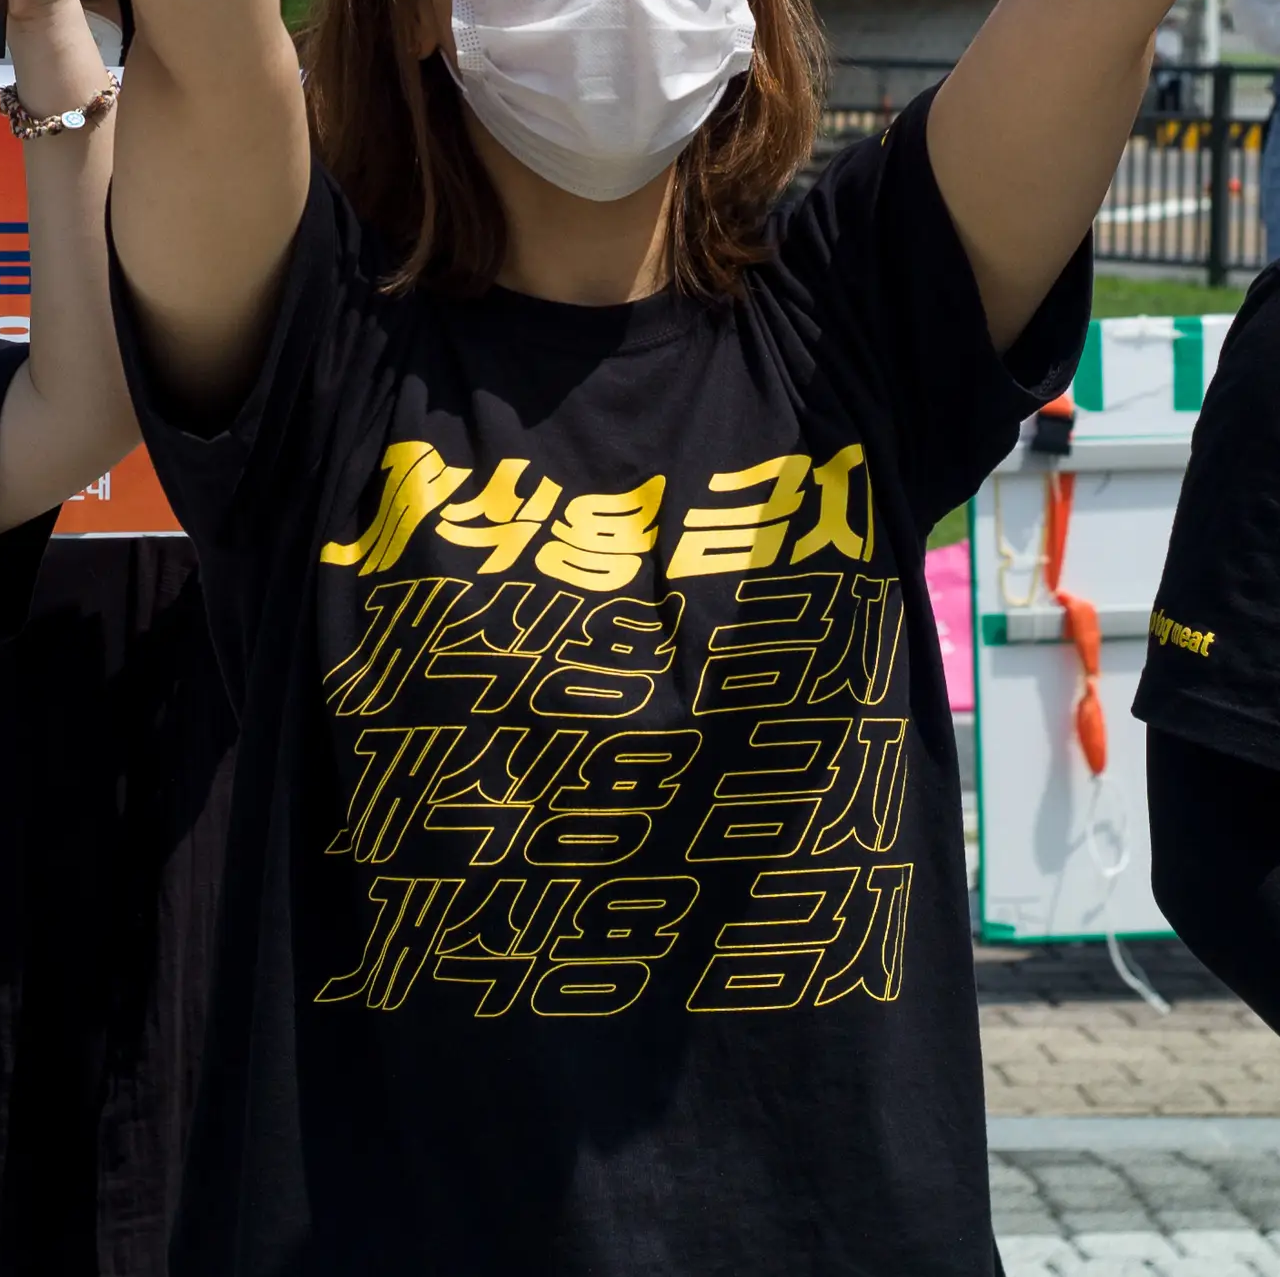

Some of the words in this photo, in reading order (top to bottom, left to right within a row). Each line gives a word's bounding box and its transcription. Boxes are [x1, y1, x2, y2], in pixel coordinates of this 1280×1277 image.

[320, 439, 667, 592] 개식용
[665, 444, 875, 580] 금지
[322, 577, 686, 719] 개식용
[692, 571, 905, 717] 금지
[323, 725, 704, 867] 개식용
[684, 717, 910, 863] 금지
[313, 875, 701, 1018] 개식용
[685, 862, 914, 1013] 금지
